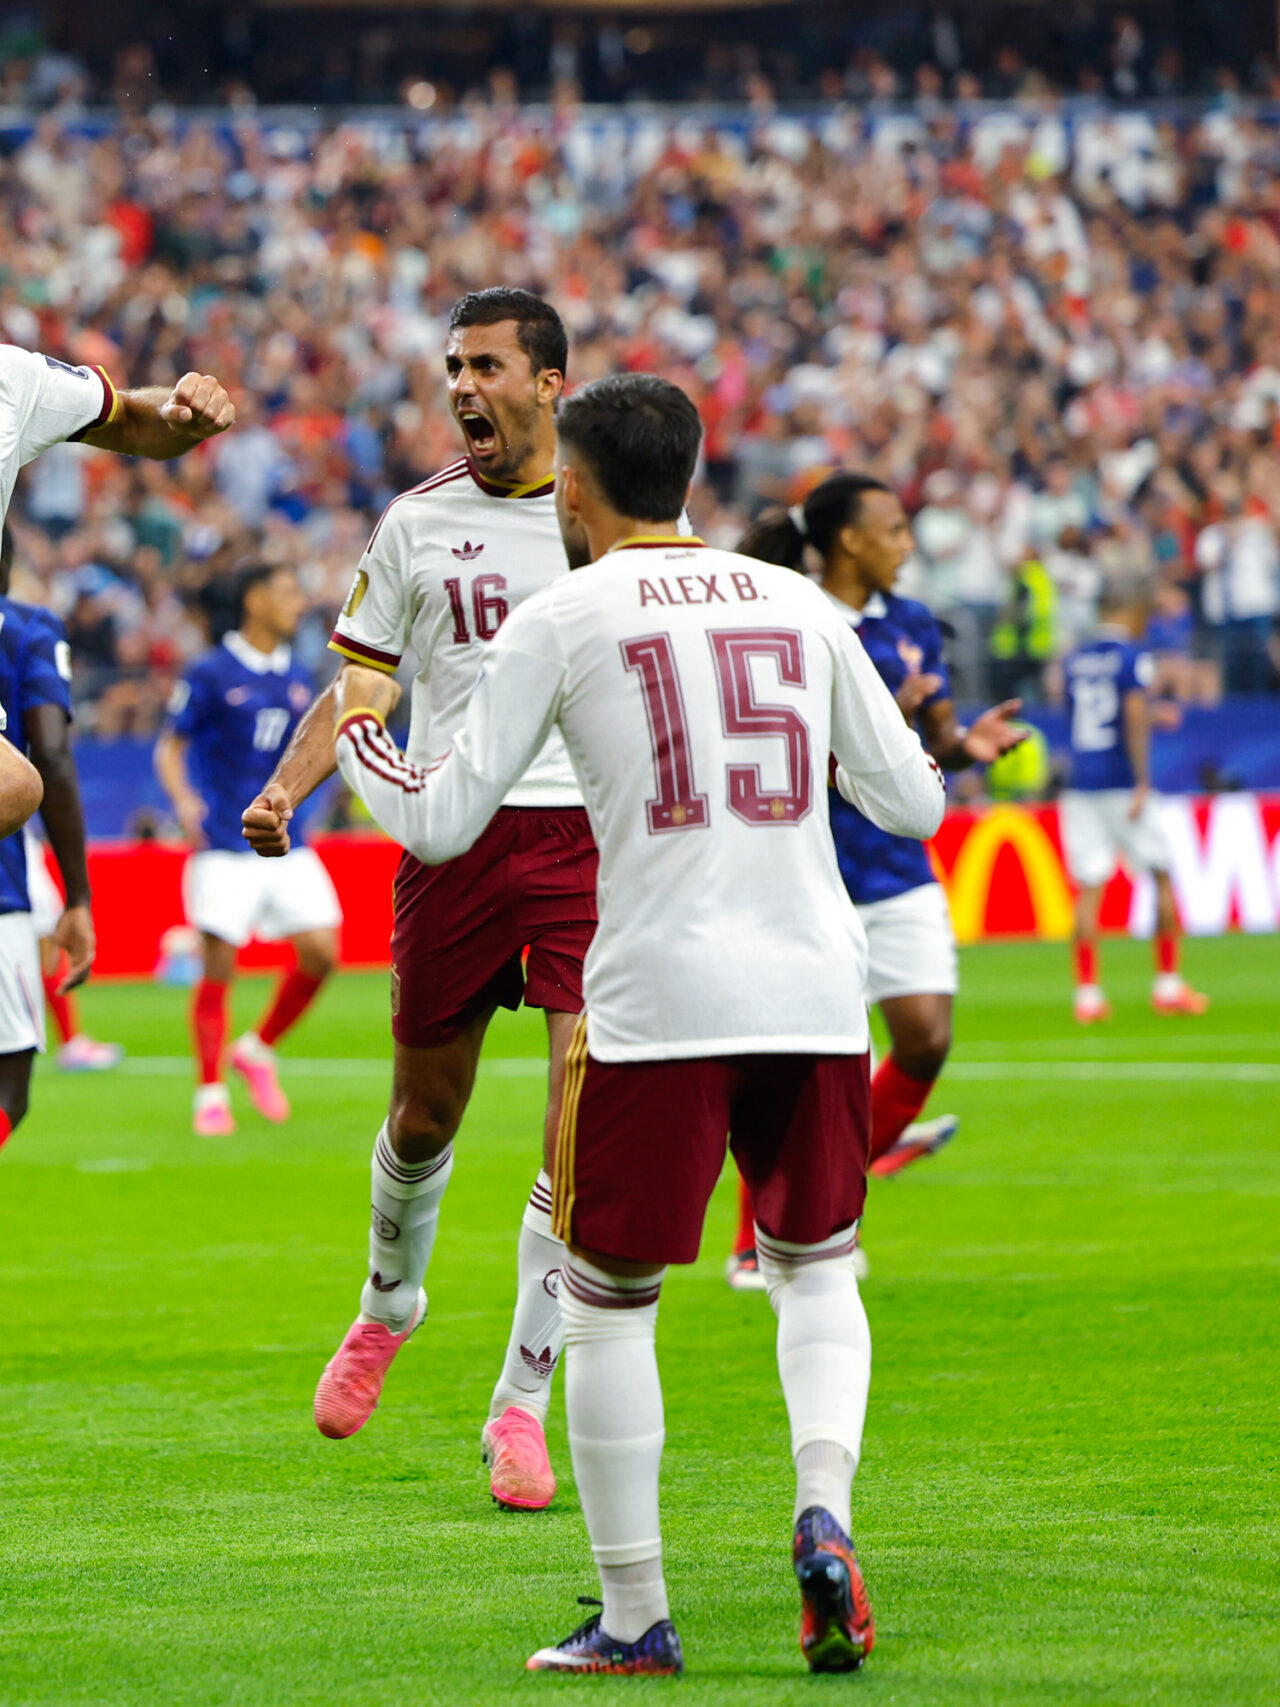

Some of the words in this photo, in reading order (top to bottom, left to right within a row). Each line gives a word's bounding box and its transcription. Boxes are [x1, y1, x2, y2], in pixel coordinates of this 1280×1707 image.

[443, 573, 509, 646] 16
[638, 574, 728, 608] ALEX
[730, 571, 768, 602] B.
[253, 707, 291, 752] 17
[618, 627, 813, 835] 15
[1071, 676, 1118, 753] 12
